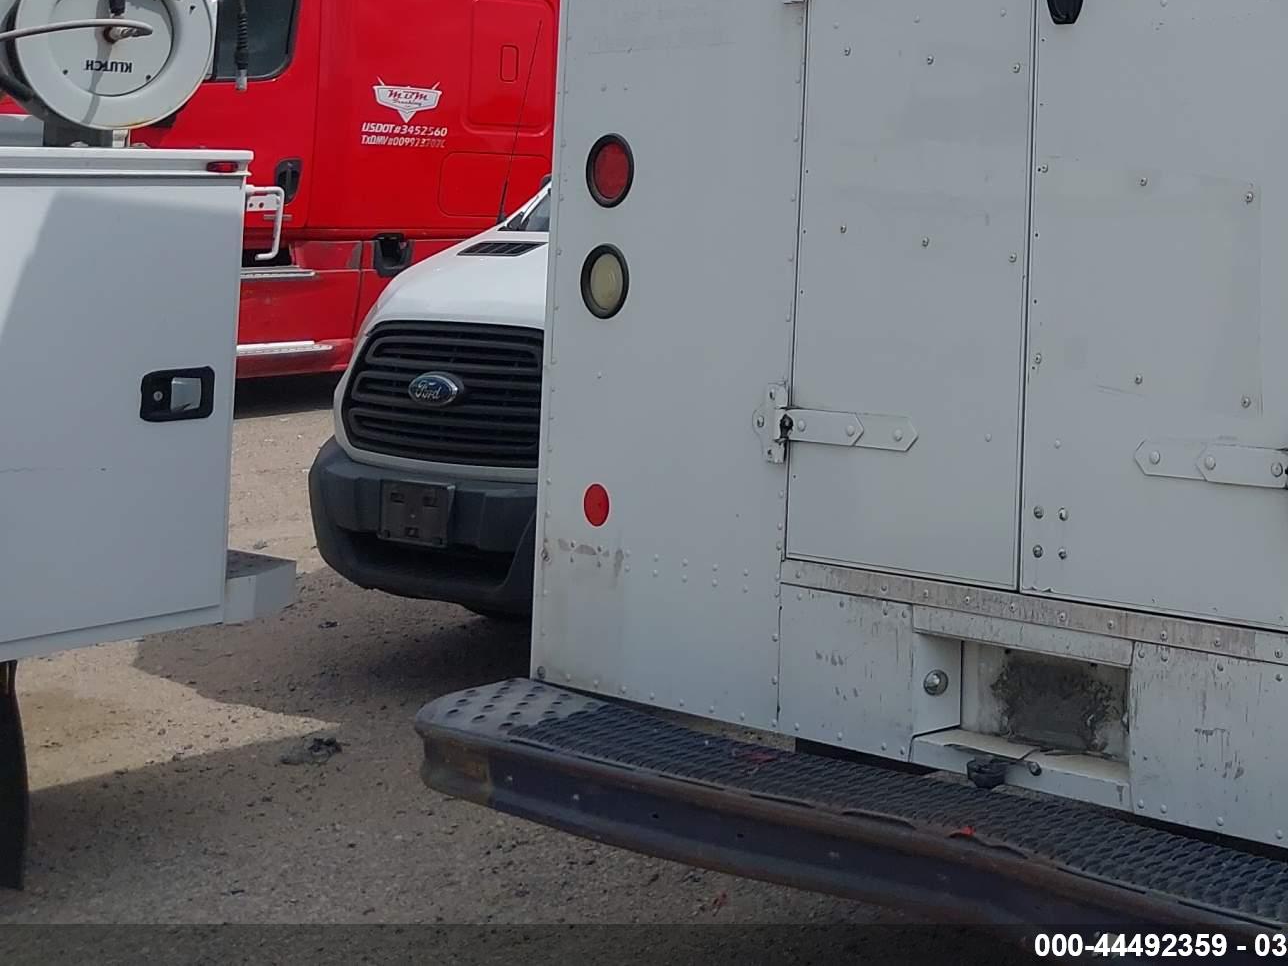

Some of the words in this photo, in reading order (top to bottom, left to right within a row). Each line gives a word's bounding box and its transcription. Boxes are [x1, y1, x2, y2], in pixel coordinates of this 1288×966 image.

[85, 59, 133, 74] KLUTCH
[361, 122, 448, 137] USDOT#3452560
[415, 379, 442, 400] Ford
